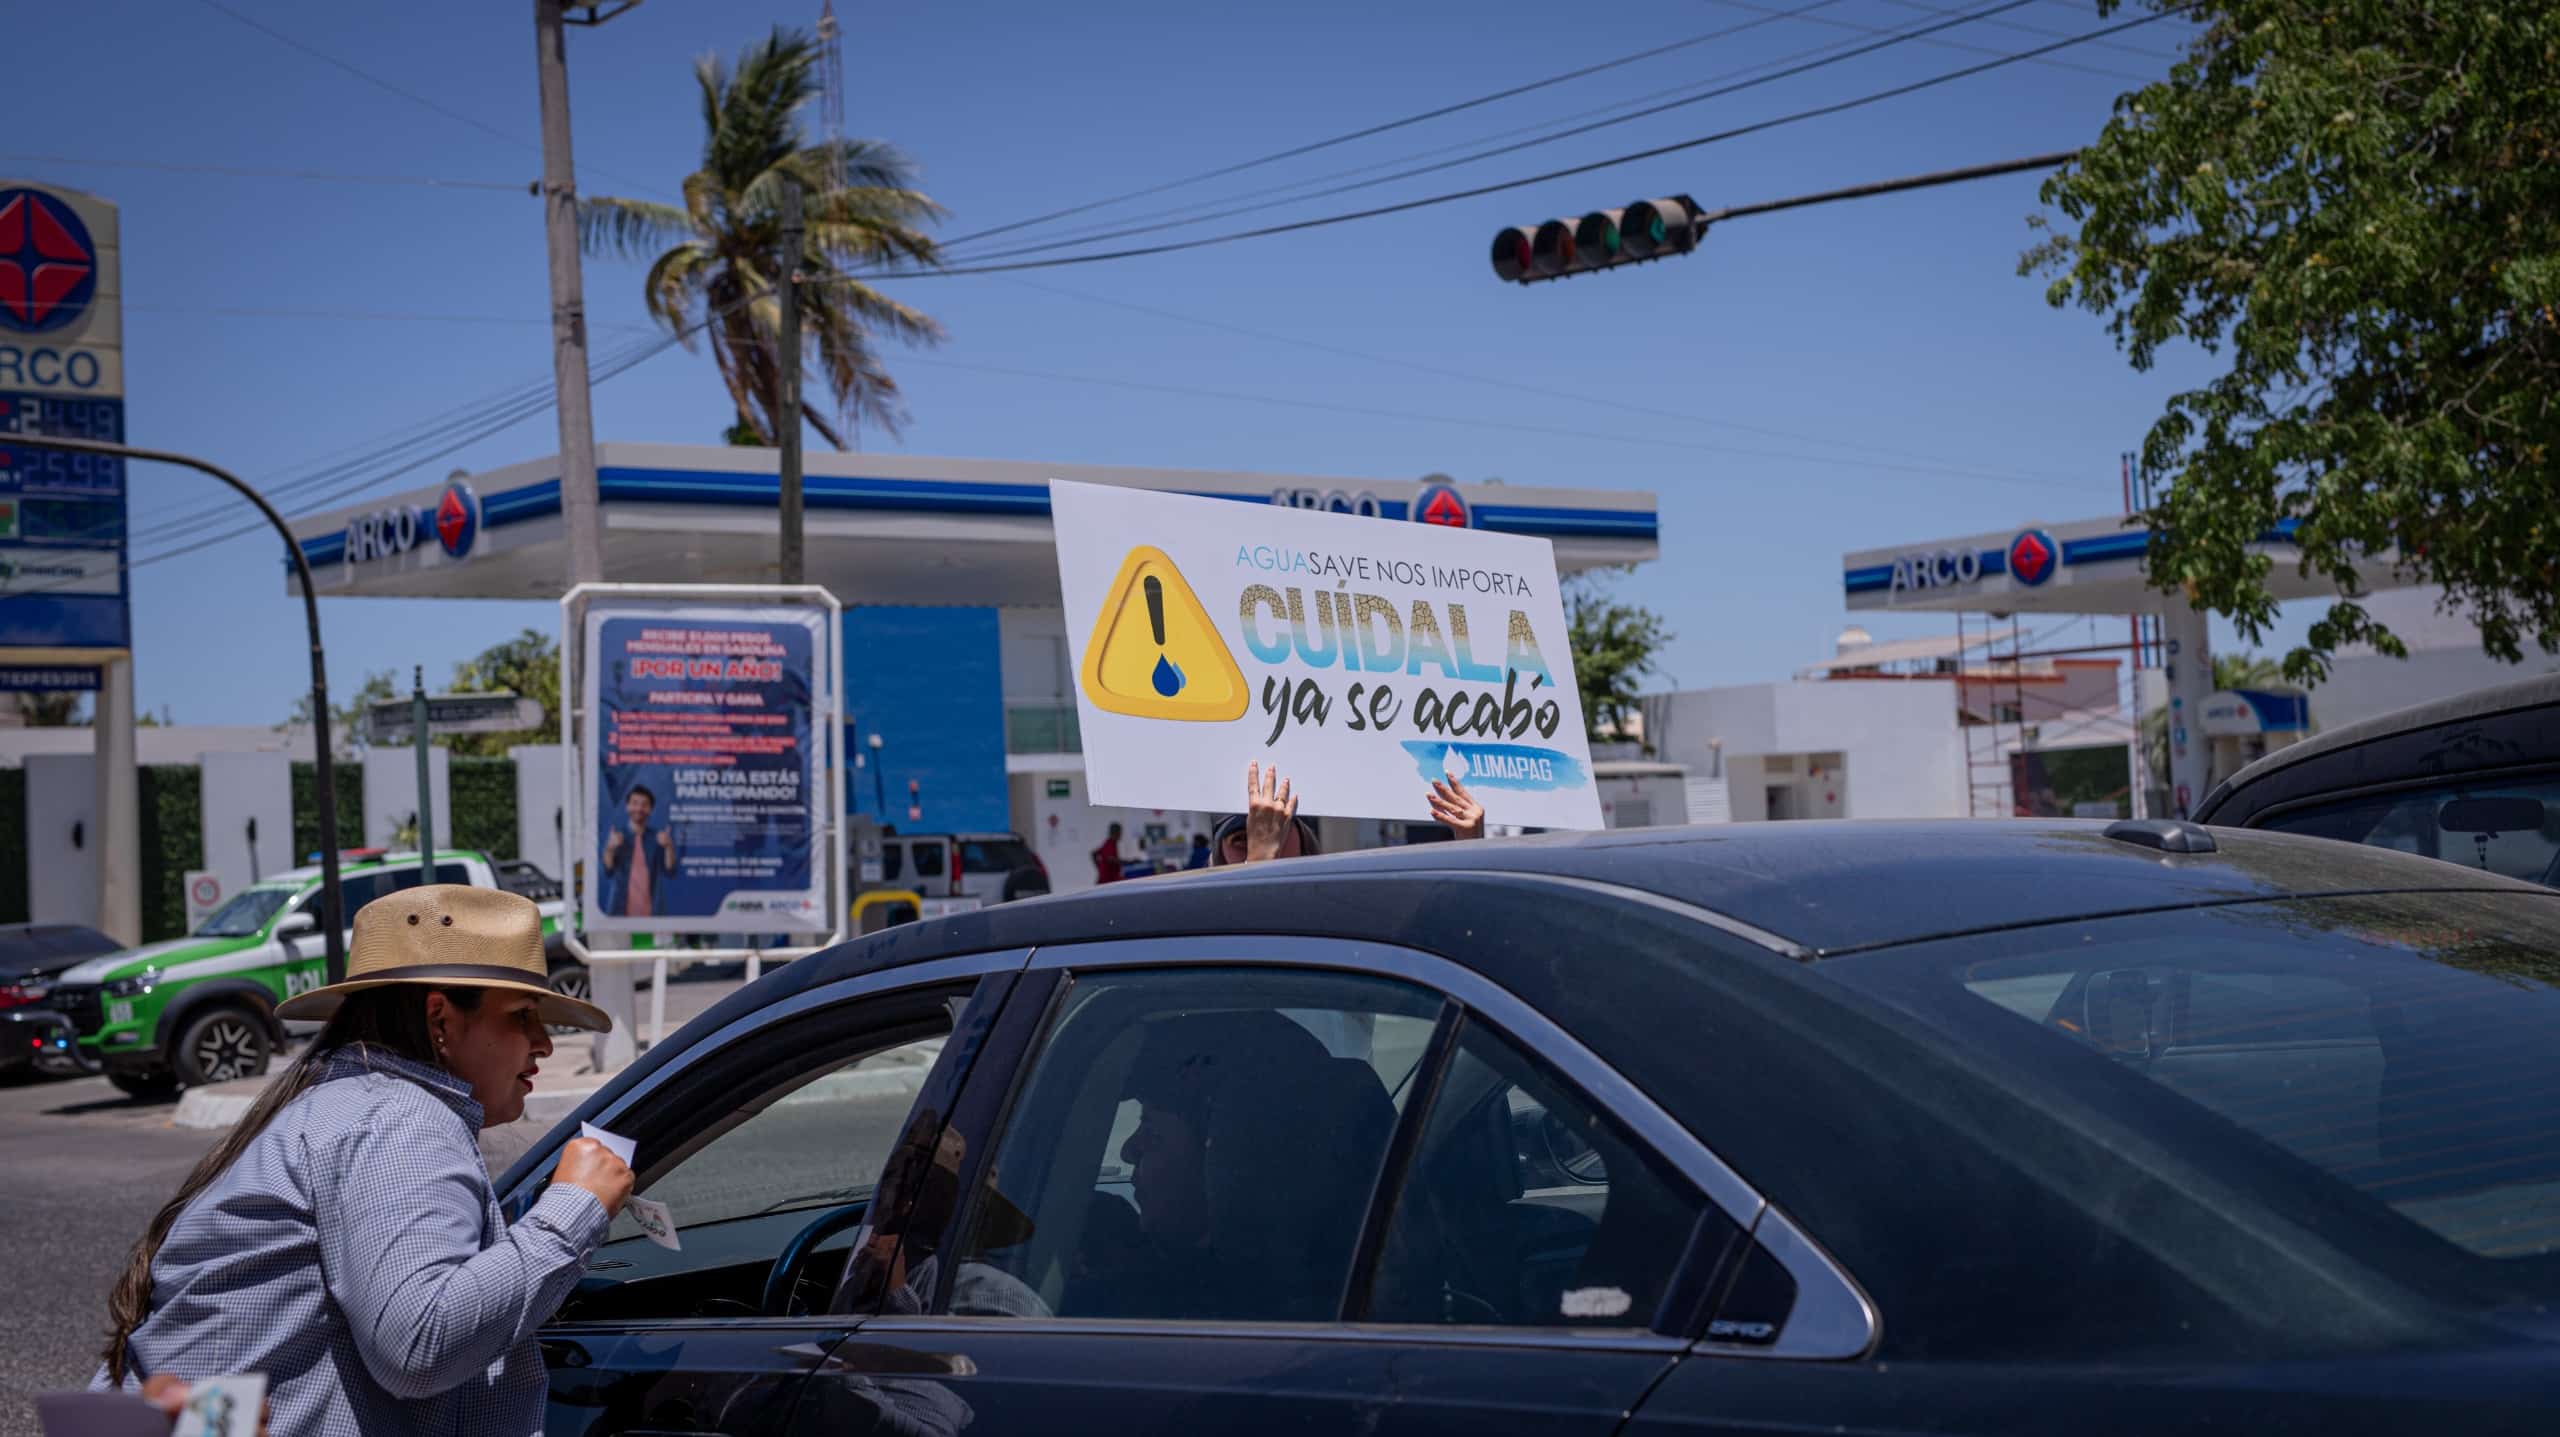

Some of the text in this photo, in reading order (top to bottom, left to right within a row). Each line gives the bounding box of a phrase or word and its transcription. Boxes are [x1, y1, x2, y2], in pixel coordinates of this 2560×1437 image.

[345, 507, 417, 561] ARCO
[1236, 544, 1533, 598] AGUASAVE NOS IMPORTA
[1889, 548, 1981, 592] ARCO
[1238, 579, 1556, 688] CUÍDALA
[630, 655, 783, 682] ¡POR UN AÑO!
[1261, 667, 1561, 748] ya se acabó
[673, 769, 718, 783] LISTO
[751, 768, 800, 785] ESTÁS
[676, 784, 797, 800] PARTICIPANDO!
